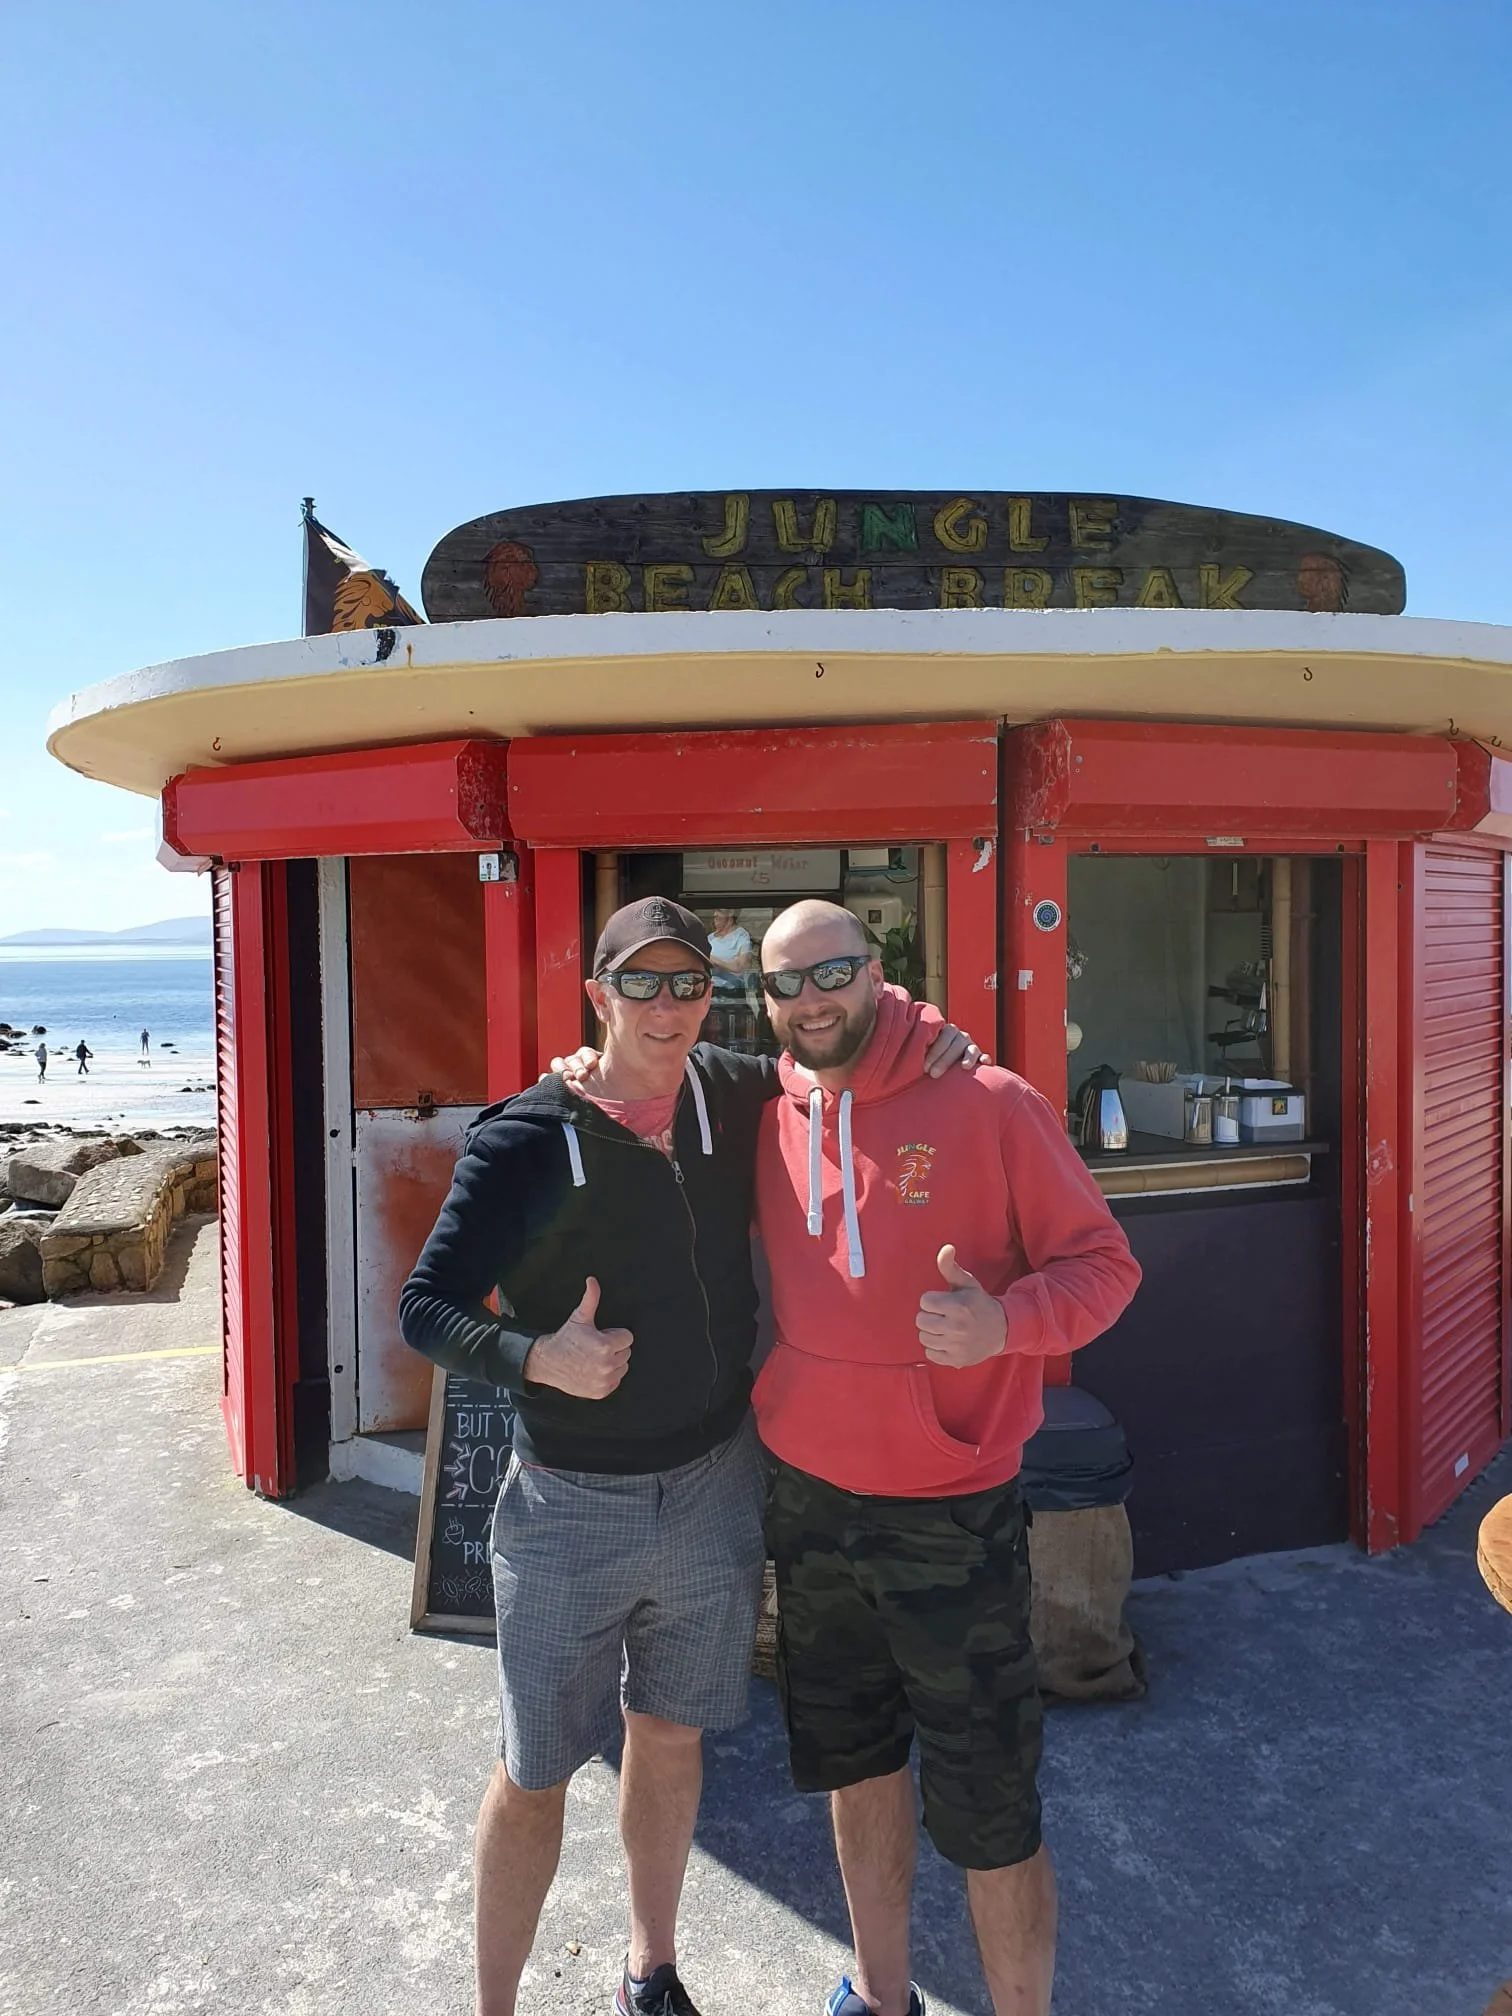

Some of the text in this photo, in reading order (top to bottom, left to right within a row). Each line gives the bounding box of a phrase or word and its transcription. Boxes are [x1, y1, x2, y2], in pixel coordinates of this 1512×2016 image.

[702, 492, 1120, 559] JUNGLE
[584, 561, 1256, 614] BEACH BREAK
[896, 1143, 937, 1157] JUNGLE
[909, 1191, 930, 1199] CAFE
[454, 1412, 495, 1439] BUT
